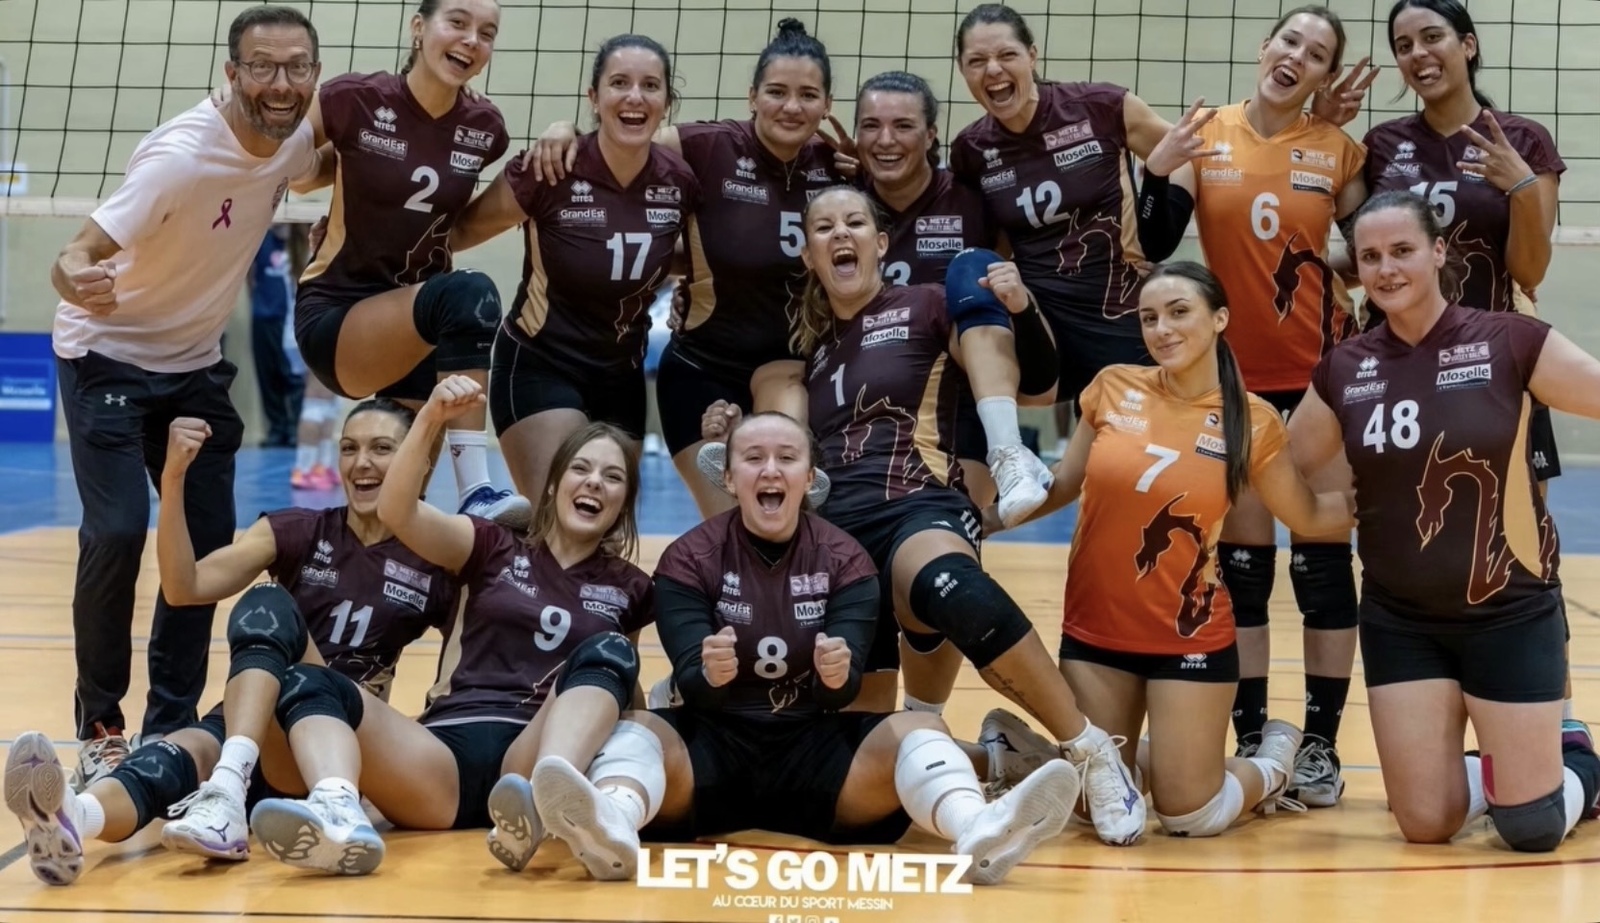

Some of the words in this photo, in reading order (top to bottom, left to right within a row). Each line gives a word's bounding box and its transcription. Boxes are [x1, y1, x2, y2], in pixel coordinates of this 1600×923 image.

[1055, 144, 1100, 165] Moselle
[403, 165, 440, 213] 2
[1292, 172, 1332, 189] Moselle
[1016, 180, 1070, 229] 12
[1251, 192, 1280, 241] 6
[606, 232, 652, 281] 17
[779, 211, 807, 257] 5
[919, 239, 961, 249] Moselle
[880, 261, 911, 287] 3
[830, 363, 846, 407] 1
[1438, 366, 1489, 383] Moselle
[1362, 399, 1421, 454] 48
[1135, 443, 1181, 493] 7
[385, 583, 425, 608] Moselle
[329, 599, 374, 647] 11
[534, 605, 571, 651] 9
[754, 636, 788, 679] 8
